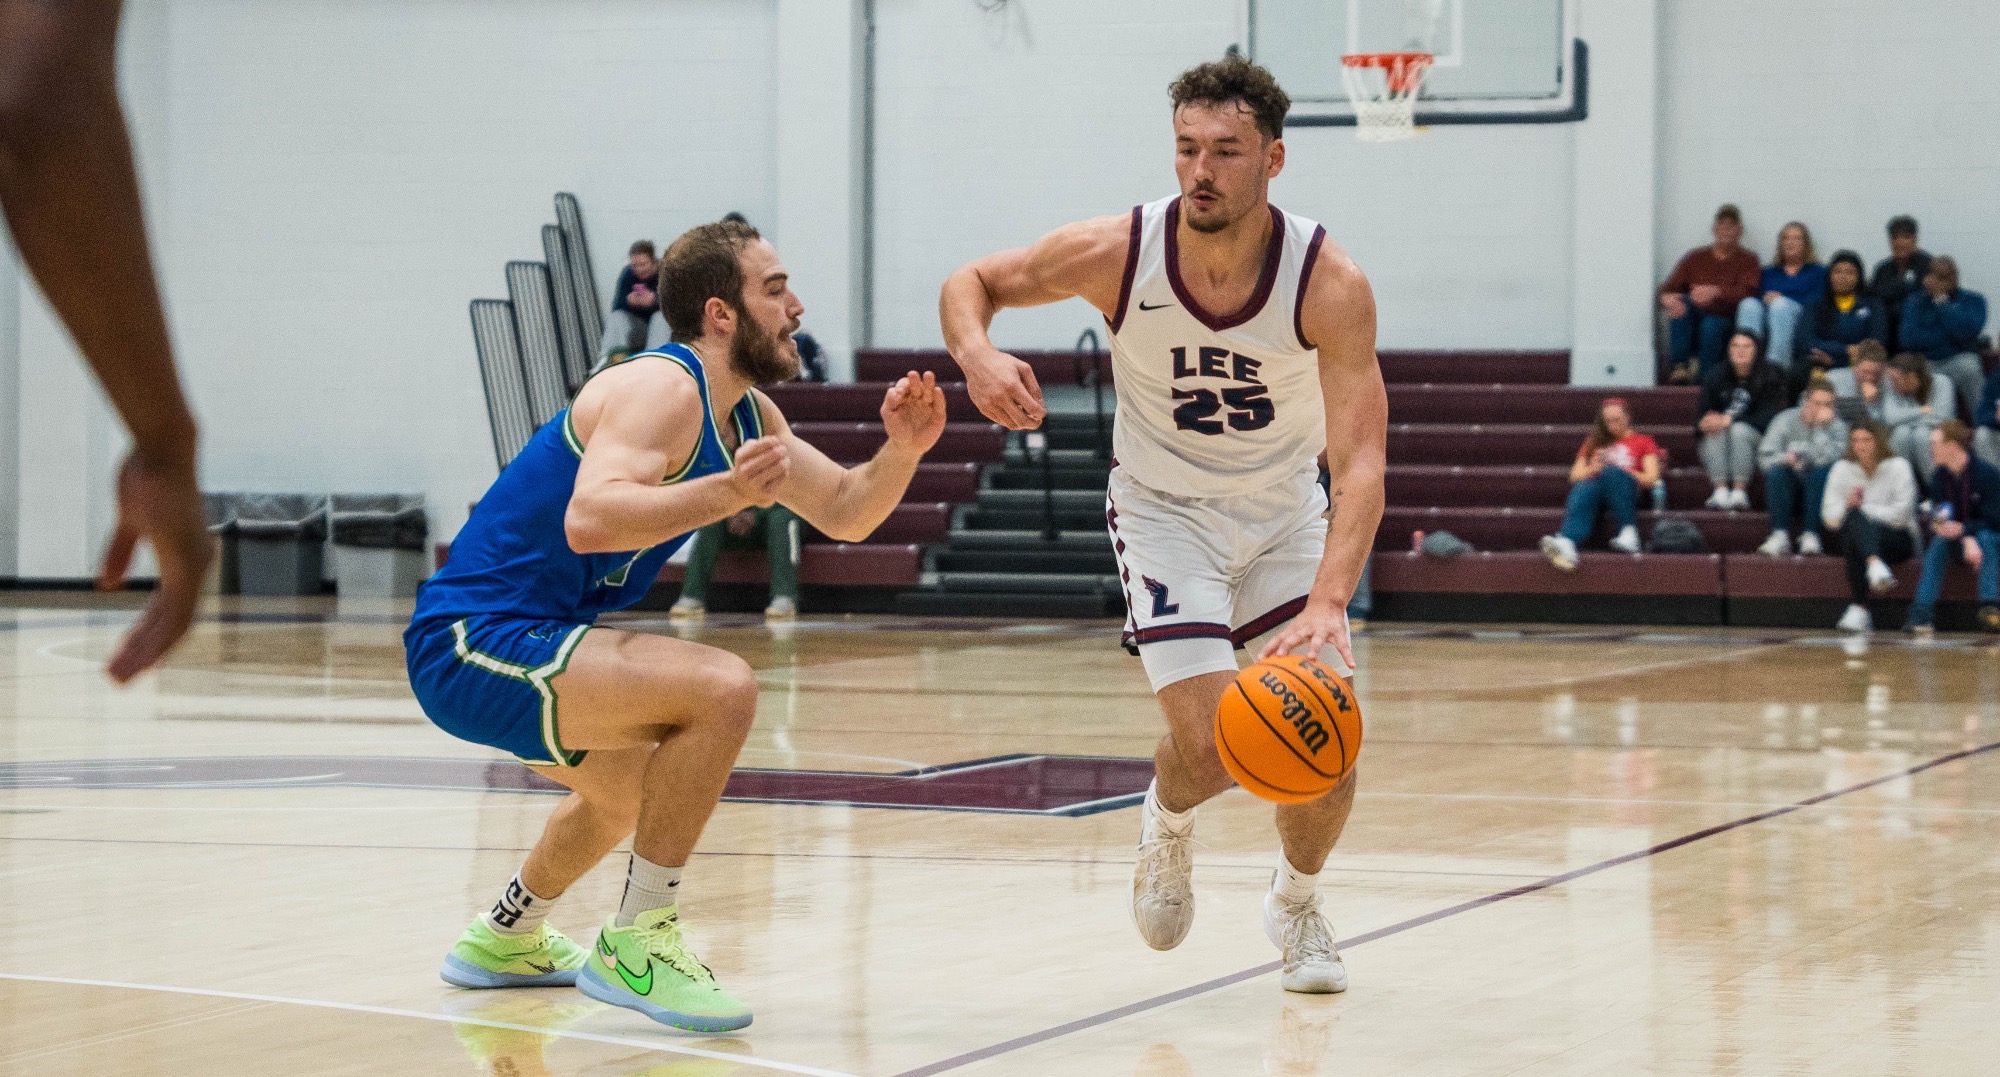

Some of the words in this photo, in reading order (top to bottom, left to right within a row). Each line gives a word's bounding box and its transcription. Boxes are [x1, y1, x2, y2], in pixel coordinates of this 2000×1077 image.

[1170, 346, 1262, 384] LEE
[1171, 385, 1275, 435] 25
[1259, 671, 1329, 756] Wilson
